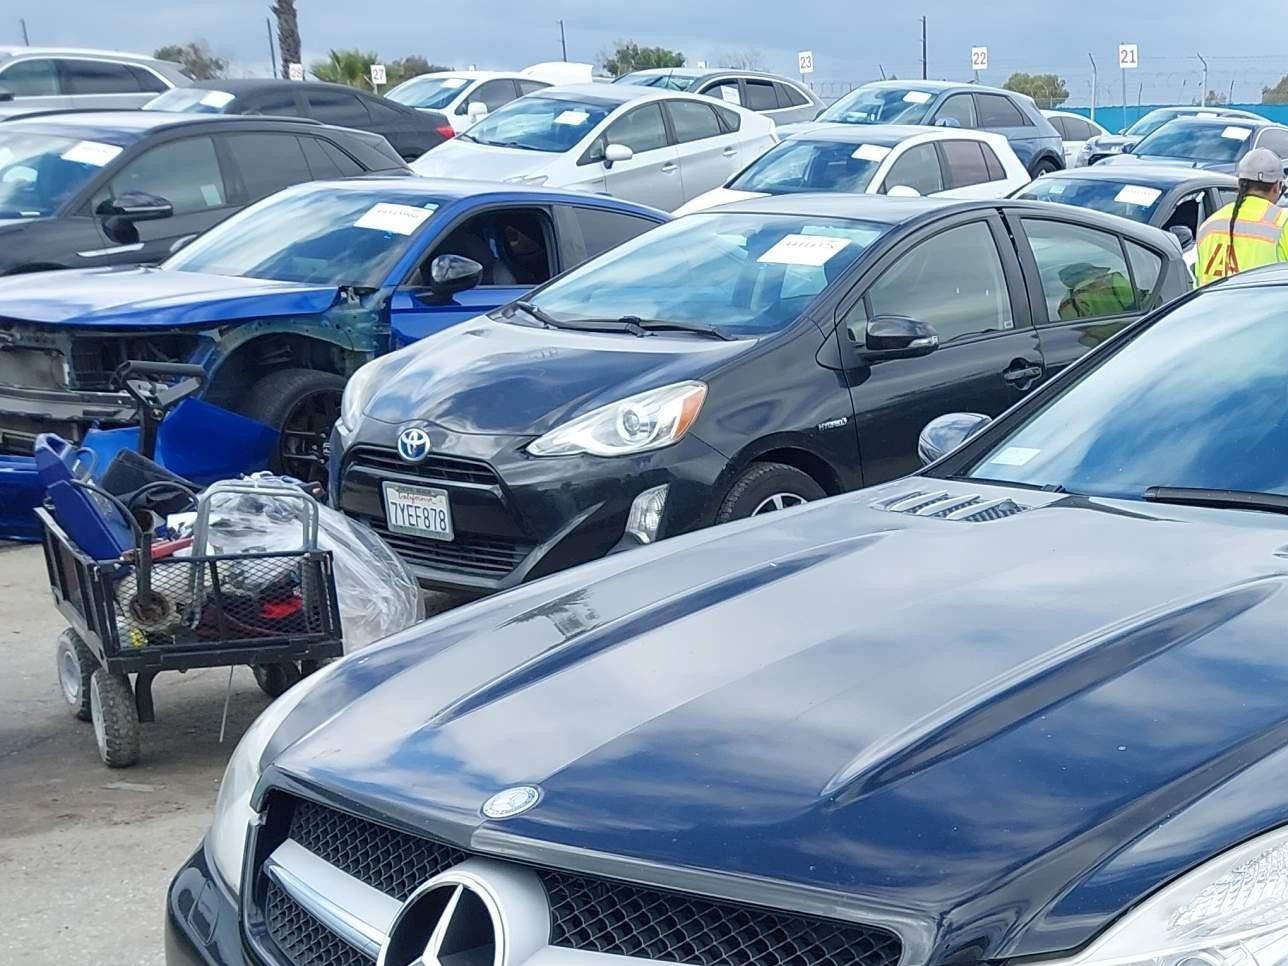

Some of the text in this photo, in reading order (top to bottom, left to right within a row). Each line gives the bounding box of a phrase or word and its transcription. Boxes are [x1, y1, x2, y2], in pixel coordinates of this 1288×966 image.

[800, 56, 812, 69] 23
[973, 52, 986, 65] 22
[1120, 50, 1136, 64] 21
[373, 68, 385, 80] 27
[390, 501, 447, 531] 7YEF878
